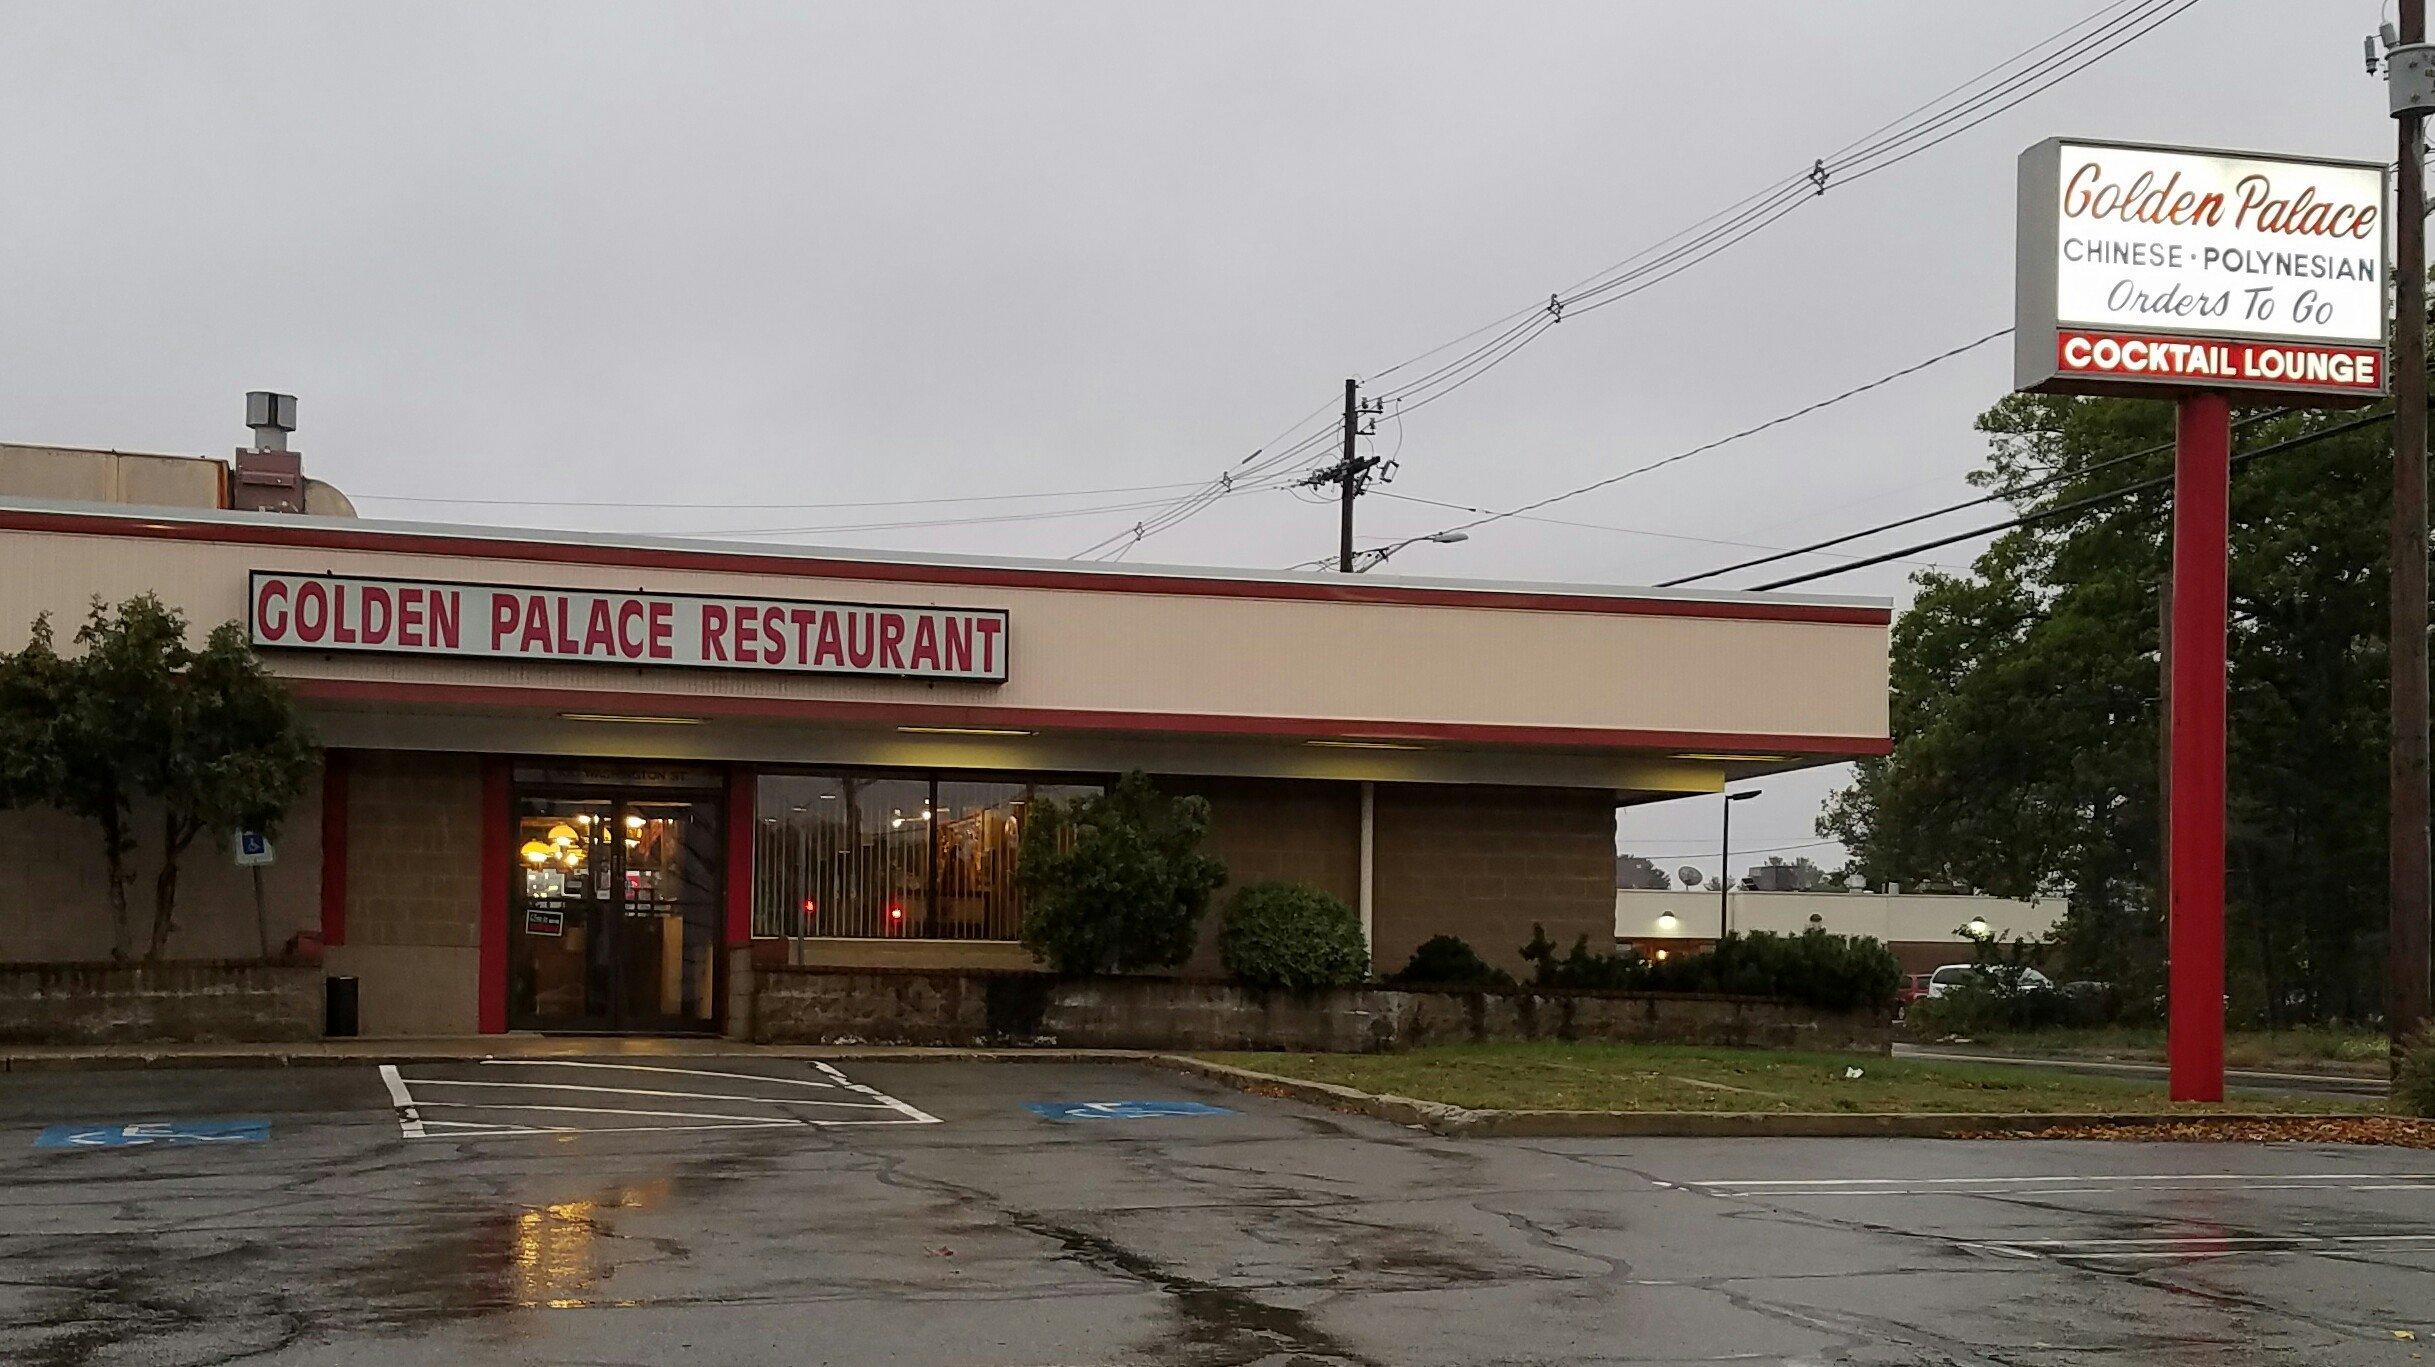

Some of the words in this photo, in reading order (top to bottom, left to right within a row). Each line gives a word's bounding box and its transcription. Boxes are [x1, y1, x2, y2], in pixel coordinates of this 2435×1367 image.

[2064, 162, 2225, 227] Golden
[2235, 174, 2378, 240] Palace
[2063, 237, 2183, 268] CHINESE
[2203, 246, 2375, 282] POLYNESIAN
[2107, 279, 2231, 317] Orders
[2244, 286, 2275, 321] To
[2292, 288, 2333, 325] Go
[2064, 337, 2238, 376] COCKTAIL
[2244, 348, 2376, 384] LOUNGE
[257, 579, 461, 649] GOLDEN
[491, 593, 674, 660] PALACE
[701, 604, 1002, 673] RESTAURANT
